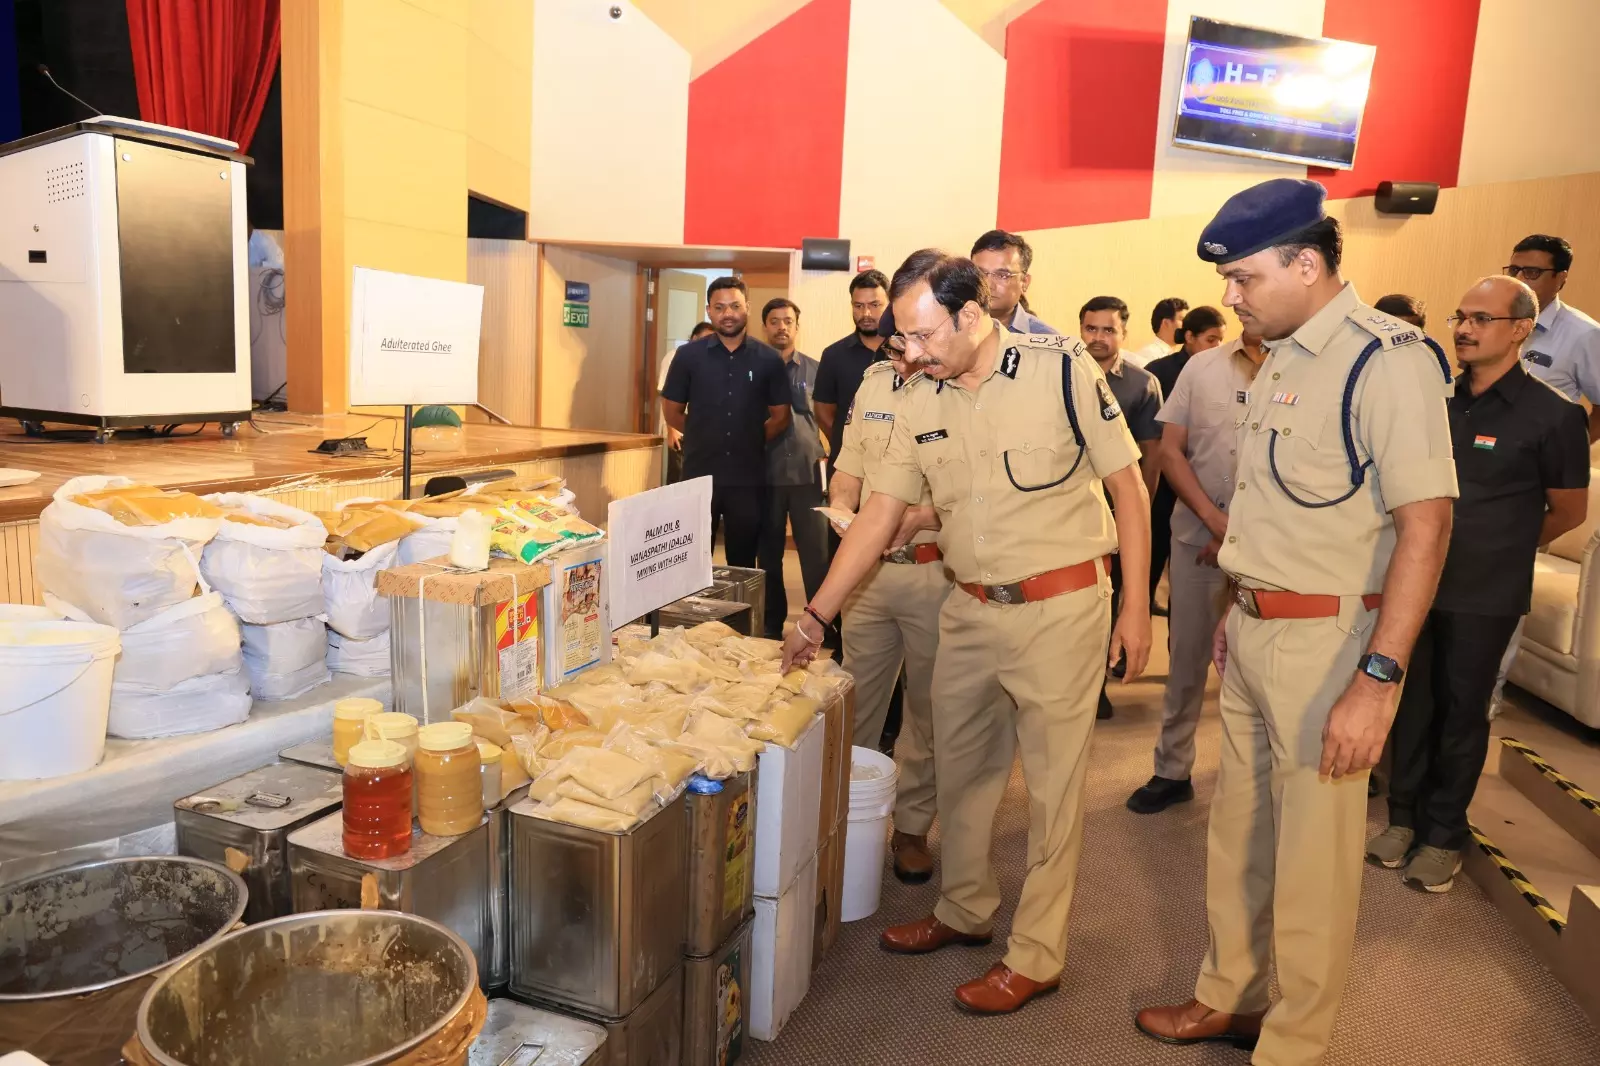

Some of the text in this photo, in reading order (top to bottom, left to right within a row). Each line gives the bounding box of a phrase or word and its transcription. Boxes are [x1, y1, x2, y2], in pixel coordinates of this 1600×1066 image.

[570, 313, 589, 324] EXIT
[380, 337, 452, 352] Adulterated Ghee
[645, 519, 681, 540] PALM OIL &
[630, 532, 694, 564] VANASPATHI (DALDA)
[636, 551, 689, 579] MIXING WITH GHEE
